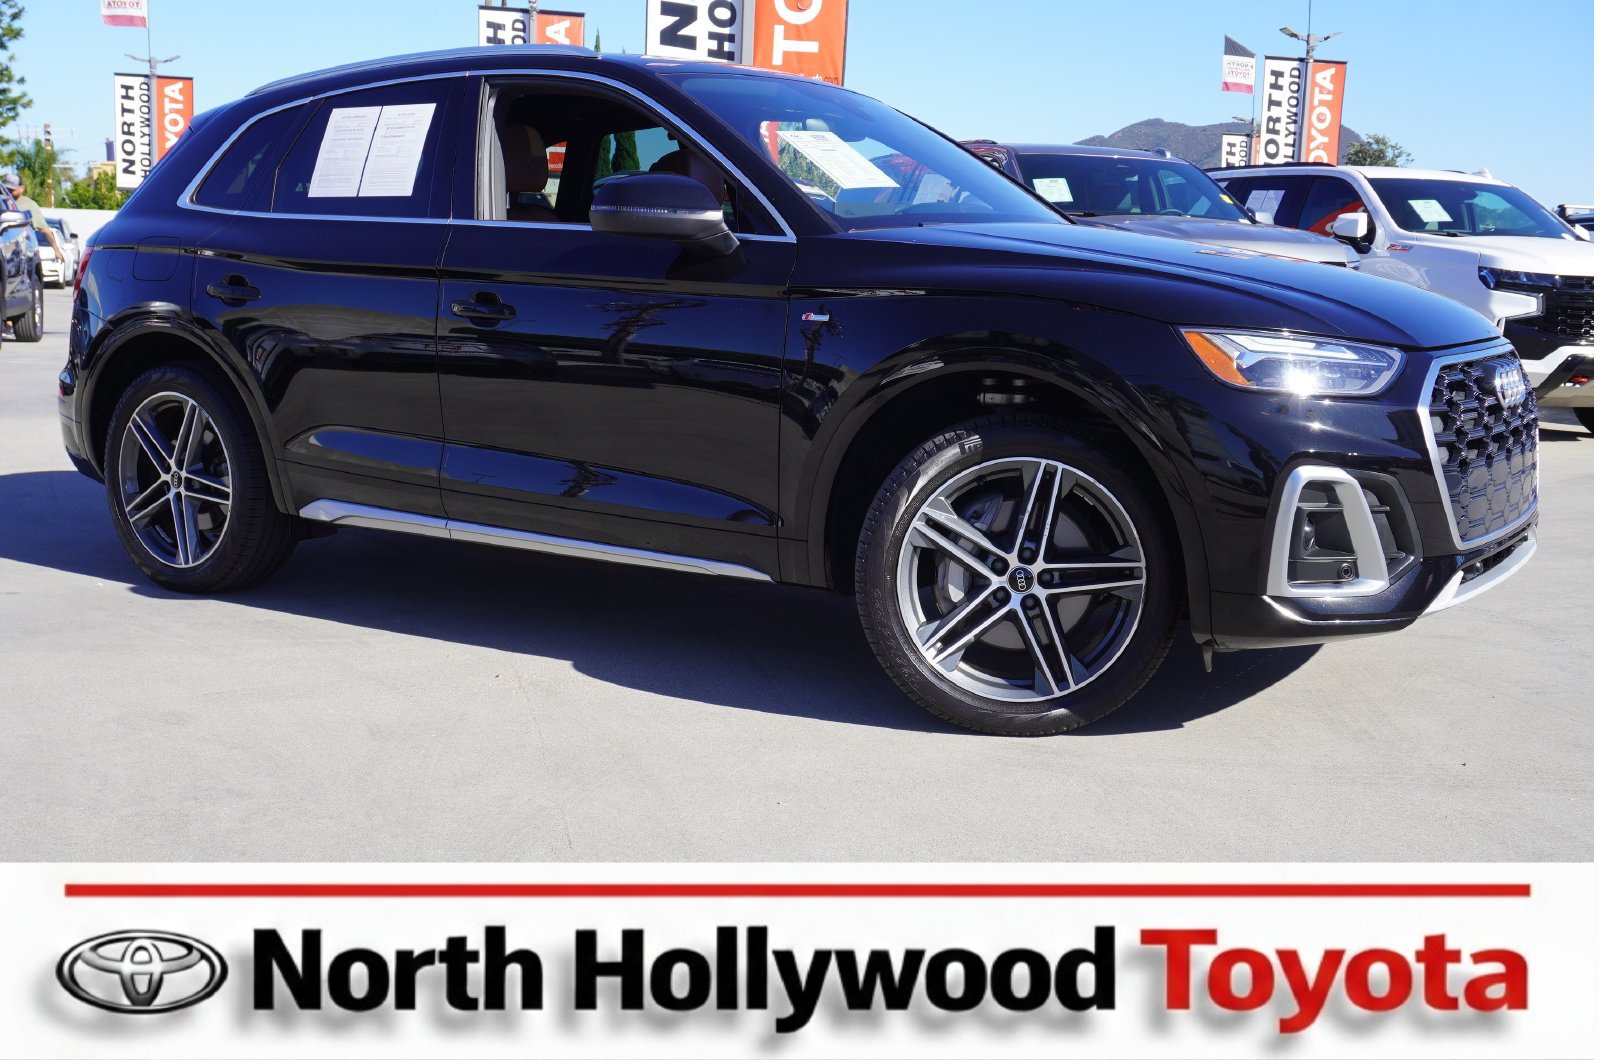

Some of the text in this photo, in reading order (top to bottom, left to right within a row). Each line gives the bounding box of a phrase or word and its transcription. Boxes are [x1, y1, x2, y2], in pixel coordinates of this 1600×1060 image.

[120, 84, 136, 175] NORTH
[1263, 69, 1286, 165] ORTH
[1282, 66, 1302, 164] LLYWOOD
